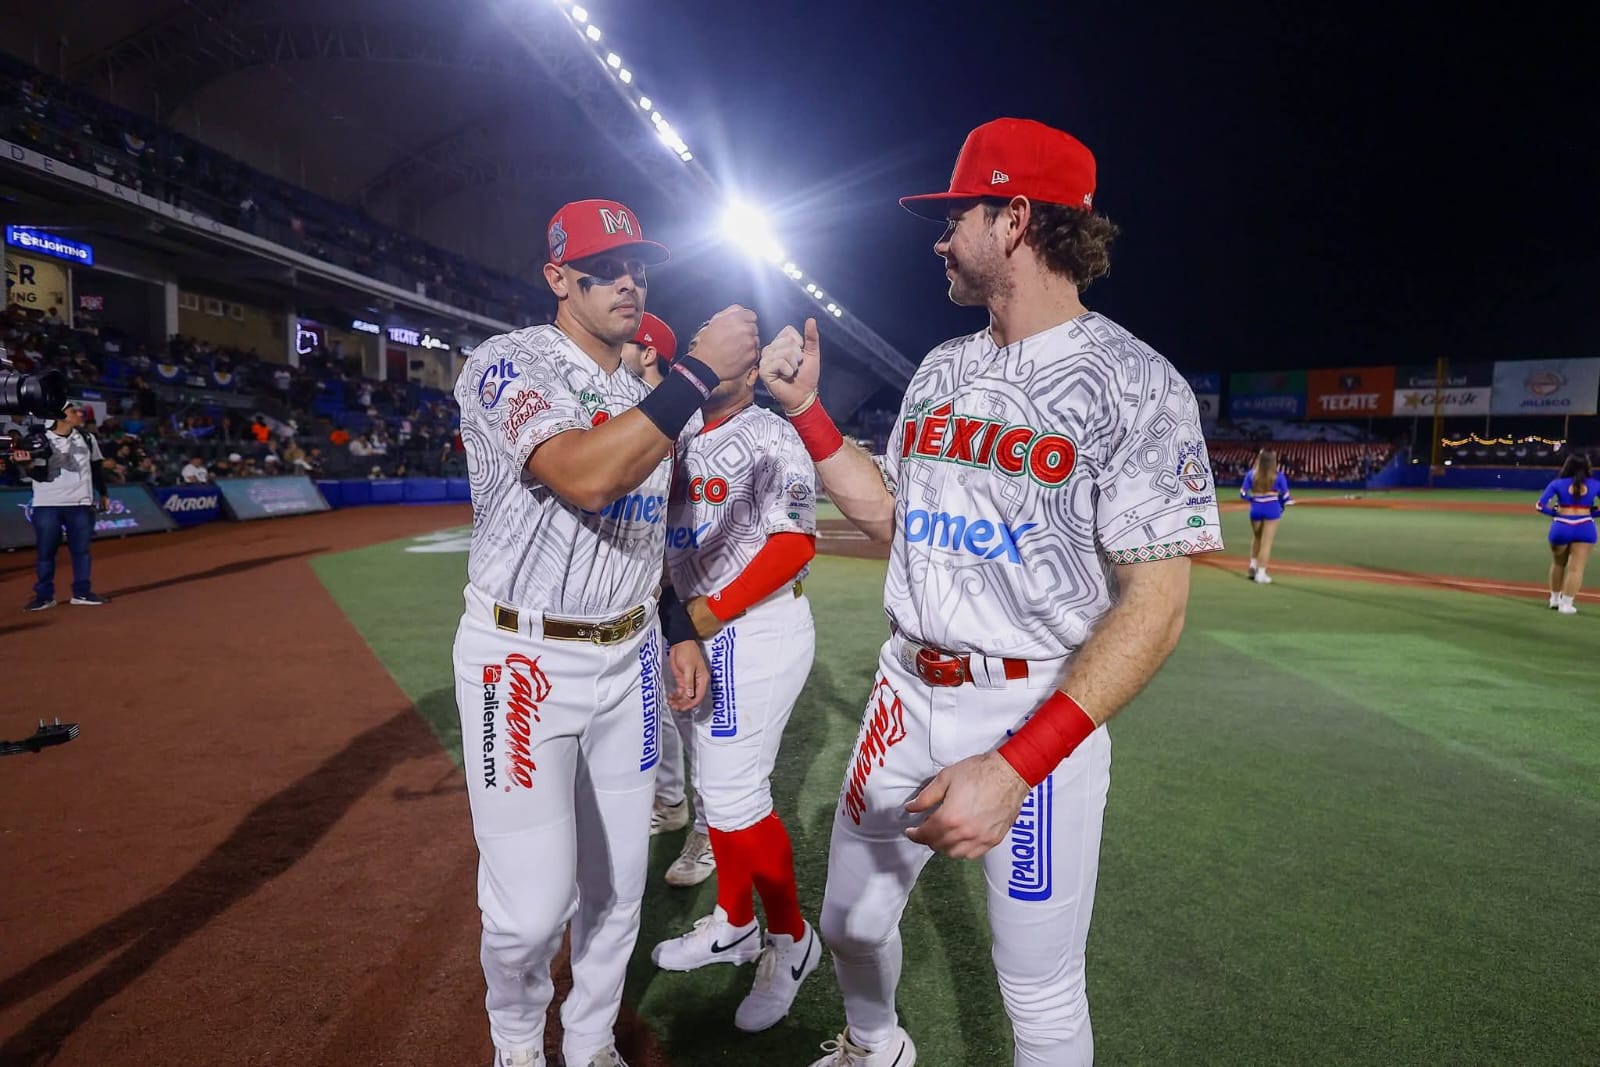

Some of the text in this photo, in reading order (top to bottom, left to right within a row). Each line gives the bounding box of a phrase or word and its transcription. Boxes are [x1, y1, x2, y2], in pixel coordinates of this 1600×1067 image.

[598, 207, 633, 236] M
[388, 327, 420, 346] TECATE
[1320, 393, 1381, 411] TECATE
[163, 493, 217, 512] AKRON
[1185, 495, 1212, 506] JALISCO
[906, 509, 1038, 564] omex
[483, 684, 499, 789] caliente.mx
